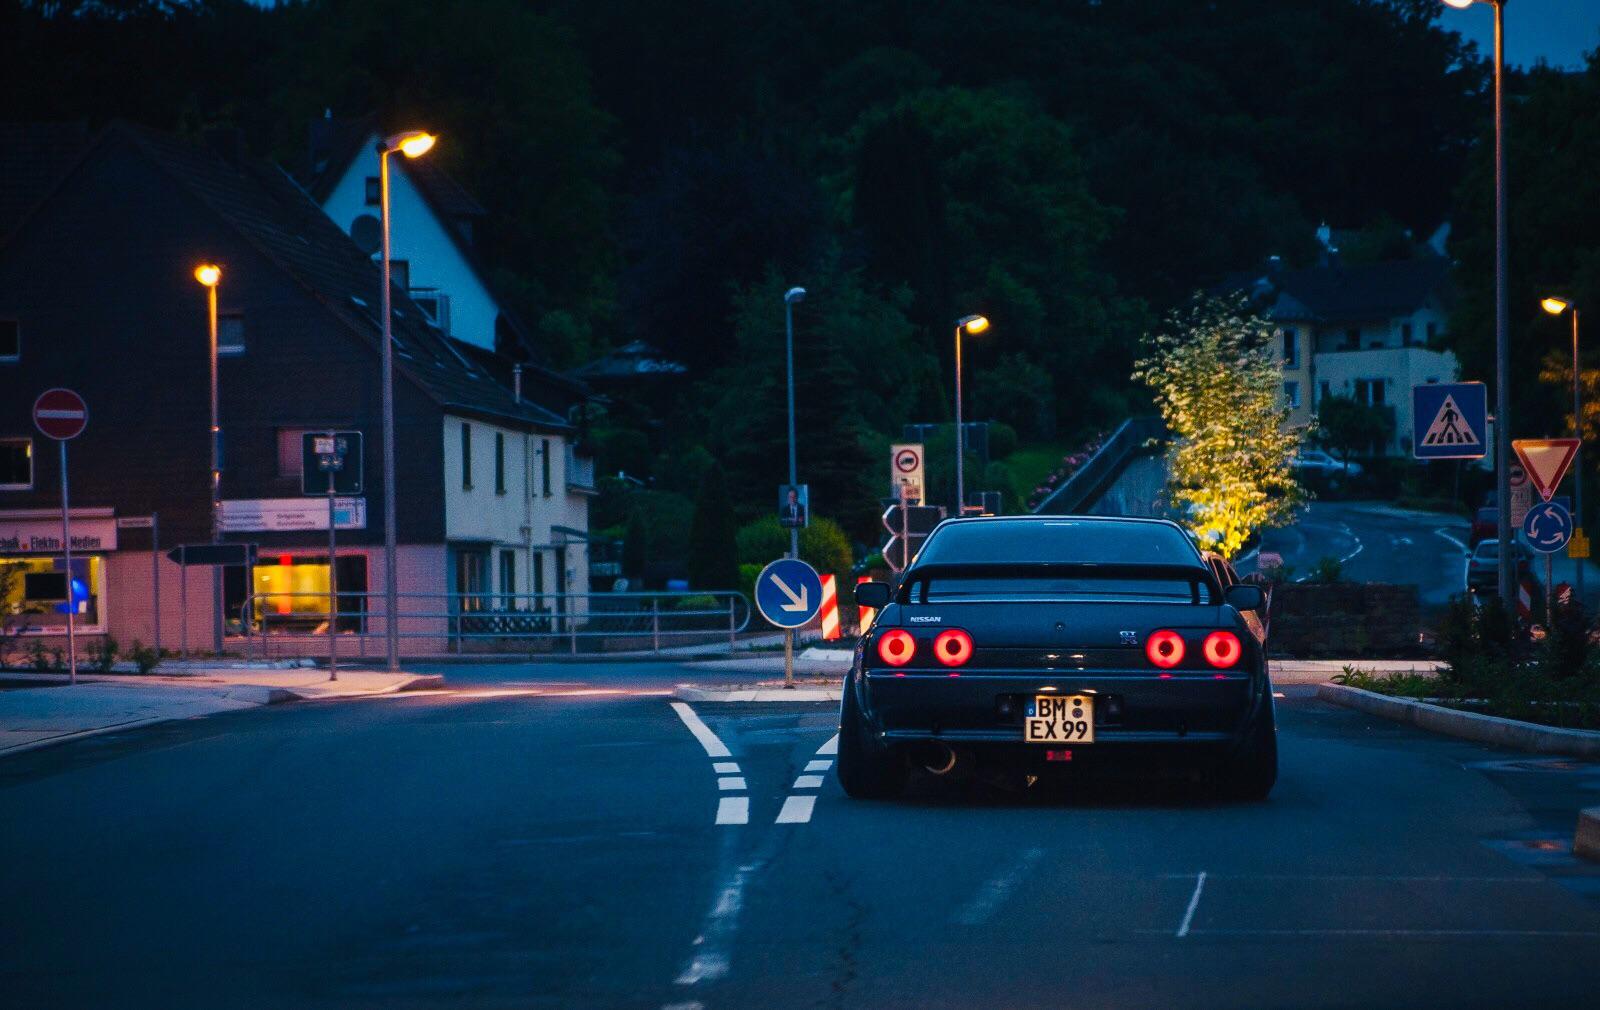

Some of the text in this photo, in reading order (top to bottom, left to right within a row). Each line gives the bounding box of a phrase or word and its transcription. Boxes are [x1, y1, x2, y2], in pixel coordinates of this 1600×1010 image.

[1038, 698, 1066, 720] BM
[1030, 720, 1088, 739] EX 99
